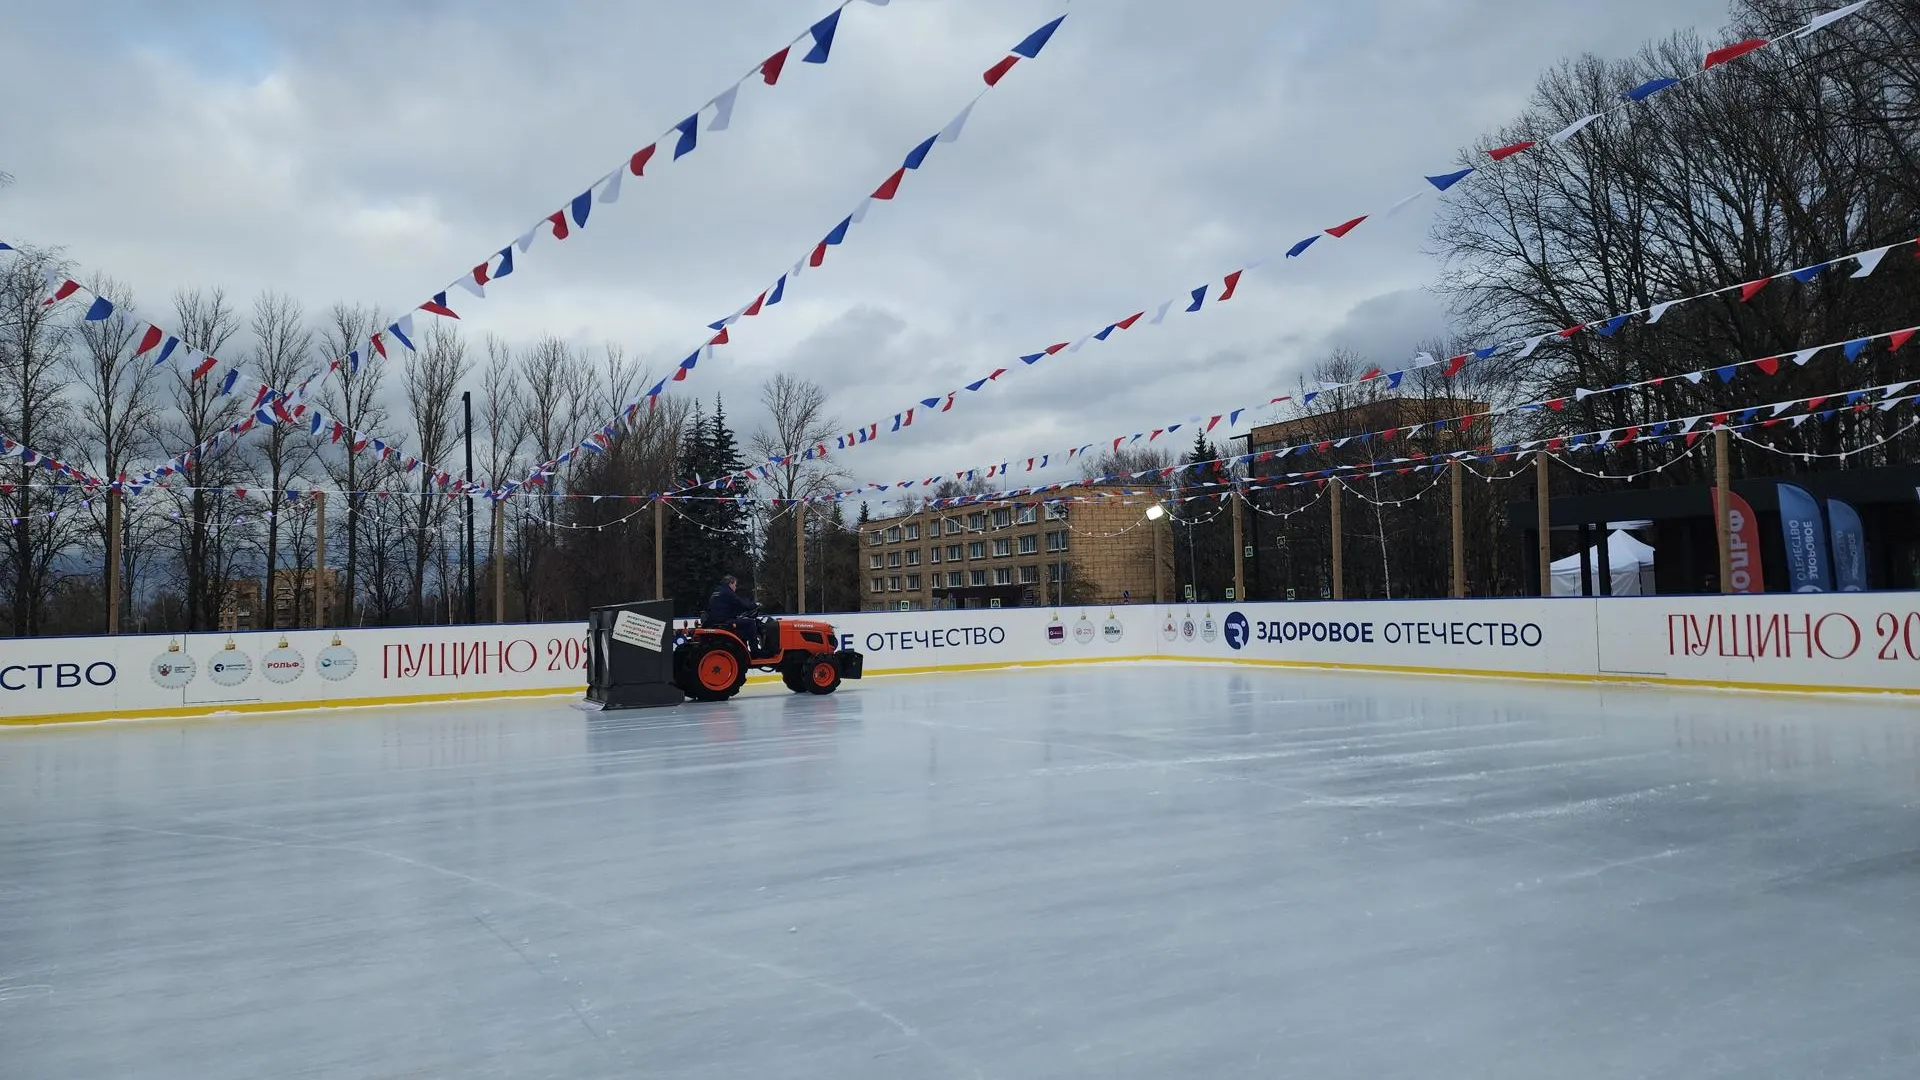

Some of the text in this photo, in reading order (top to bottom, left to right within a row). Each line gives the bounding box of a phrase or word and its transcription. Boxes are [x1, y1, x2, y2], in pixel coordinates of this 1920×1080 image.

[866, 626, 1005, 652] ОТЕЧЕСТВО
[1256, 621, 1542, 647] ЗДОРОВОЕ ОТЕЧЕСТВО
[1668, 611, 1920, 662] ПУЩИНО 20
[267, 661, 300, 669] РОЛЬФ
[383, 639, 538, 680] ПУЩИНО
[0, 661, 117, 690] СТВО
